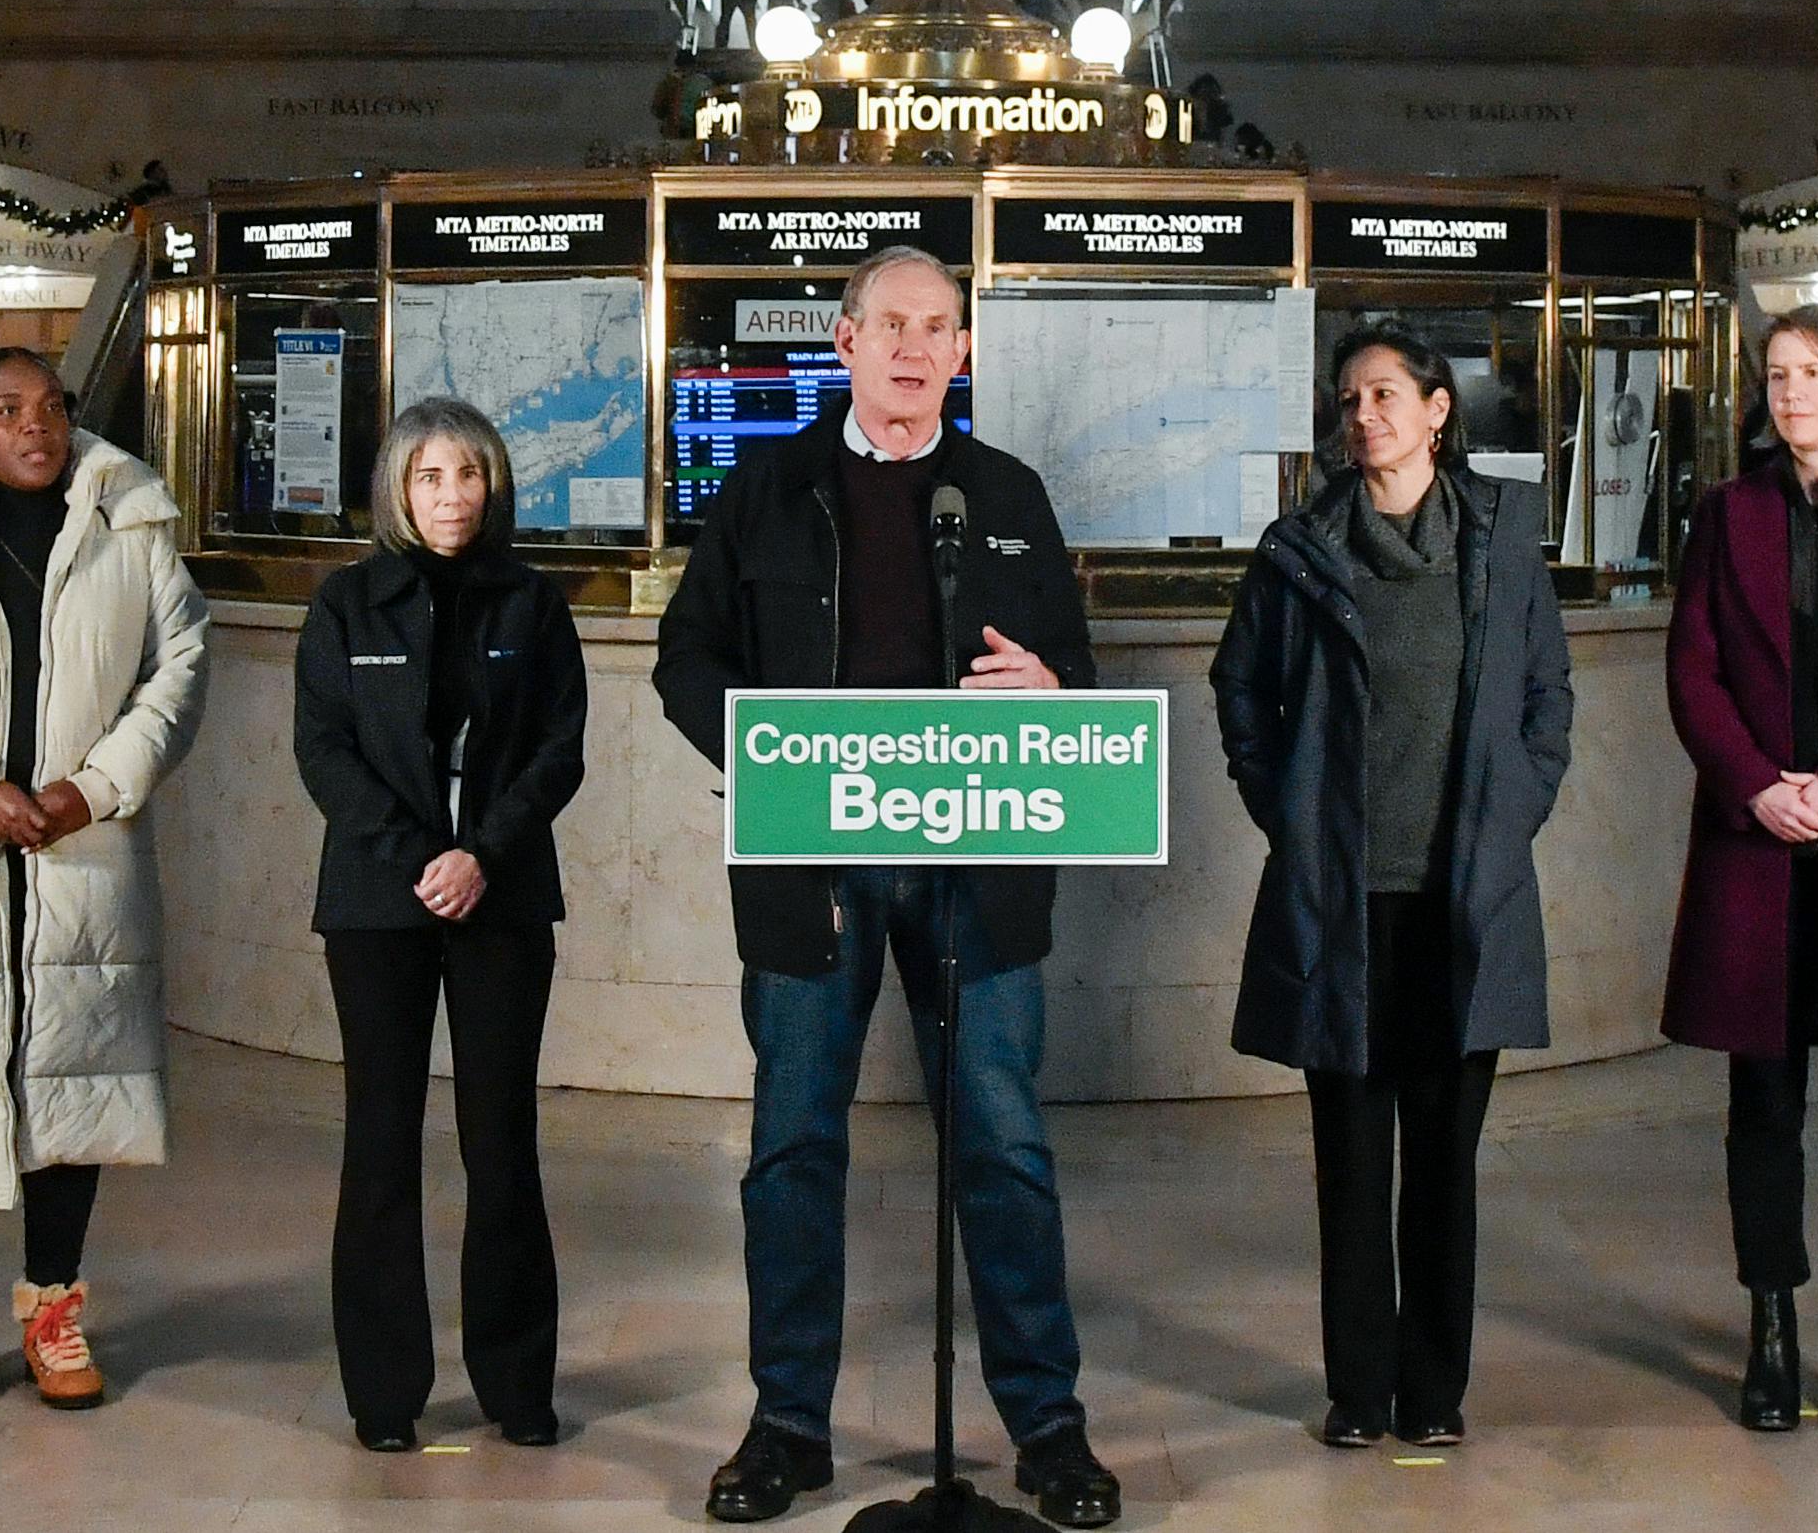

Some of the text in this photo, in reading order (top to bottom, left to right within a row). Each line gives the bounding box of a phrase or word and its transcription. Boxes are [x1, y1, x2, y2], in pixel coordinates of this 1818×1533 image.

[268, 98, 321, 116] EAST
[858, 86, 1103, 132] Information
[435, 214, 604, 234] MTA METRO-NORTH
[718, 212, 921, 230] MTA METRO-NORTH
[1044, 214, 1242, 233] MTA METRO-NORTH
[1351, 218, 1507, 240] MTA METRO-NORTH
[244, 221, 352, 242] MTA METRO-NORTH
[770, 232, 869, 250] ARRIVALS
[264, 241, 330, 260] TIMETABLES
[468, 235, 570, 253] TIMETABLES
[1084, 235, 1204, 253] TIMETABLES
[1383, 239, 1477, 258] TIMETABLES
[746, 311, 834, 333] ARRIV
[1594, 478, 1631, 497] LOSED
[745, 723, 1149, 772] Congestion Relief
[830, 773, 1065, 845] Begins
